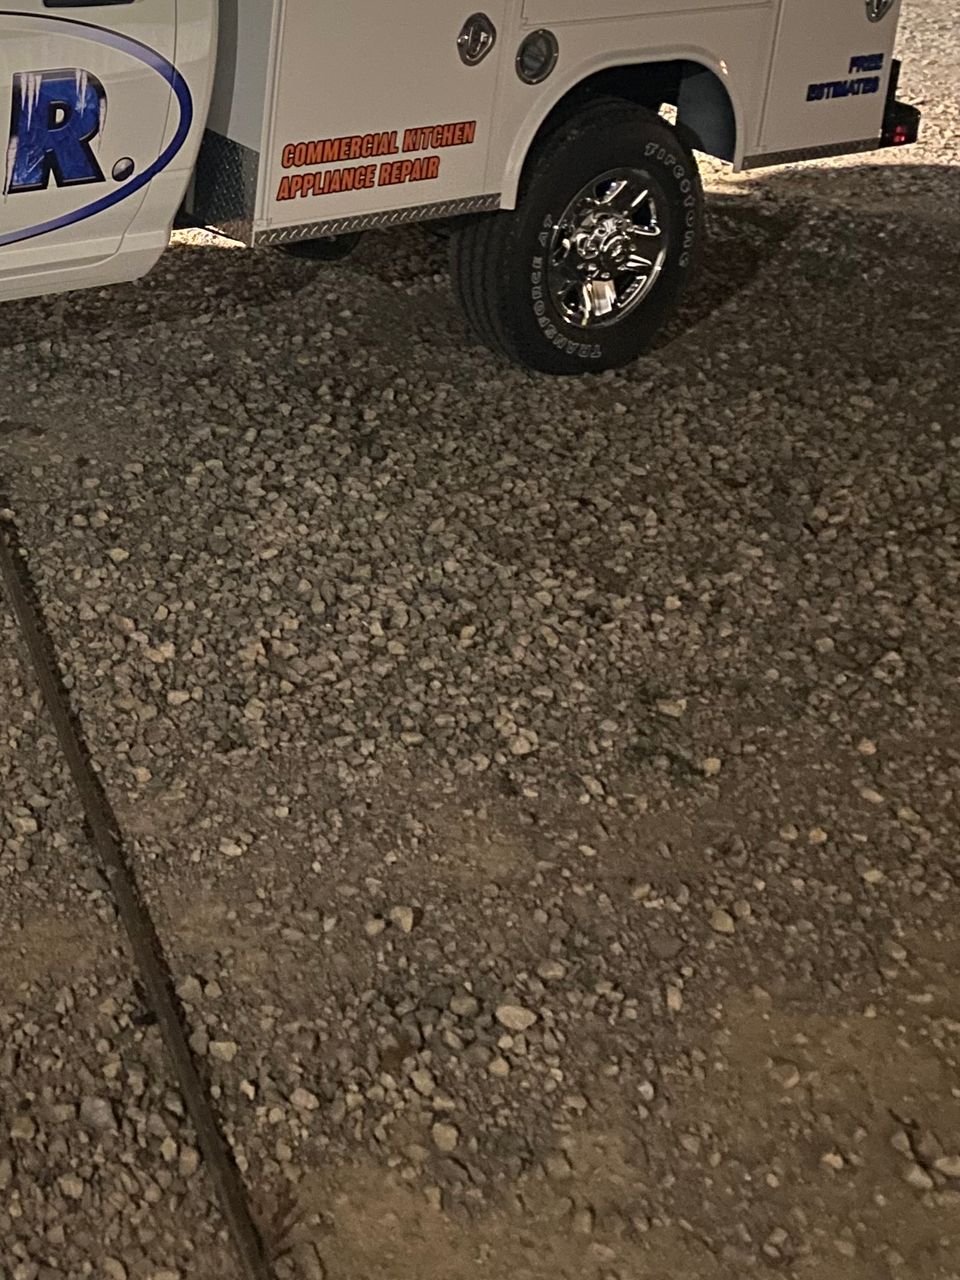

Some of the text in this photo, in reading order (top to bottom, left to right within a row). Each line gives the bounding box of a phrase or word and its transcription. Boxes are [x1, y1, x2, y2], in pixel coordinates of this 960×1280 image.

[848, 53, 884, 74] FREE
[806, 77, 880, 102] ESTIMATES
[281, 121, 477, 168] COMMERCIAL KITCHEN
[276, 156, 441, 201] APPLIANCE REPAIR
